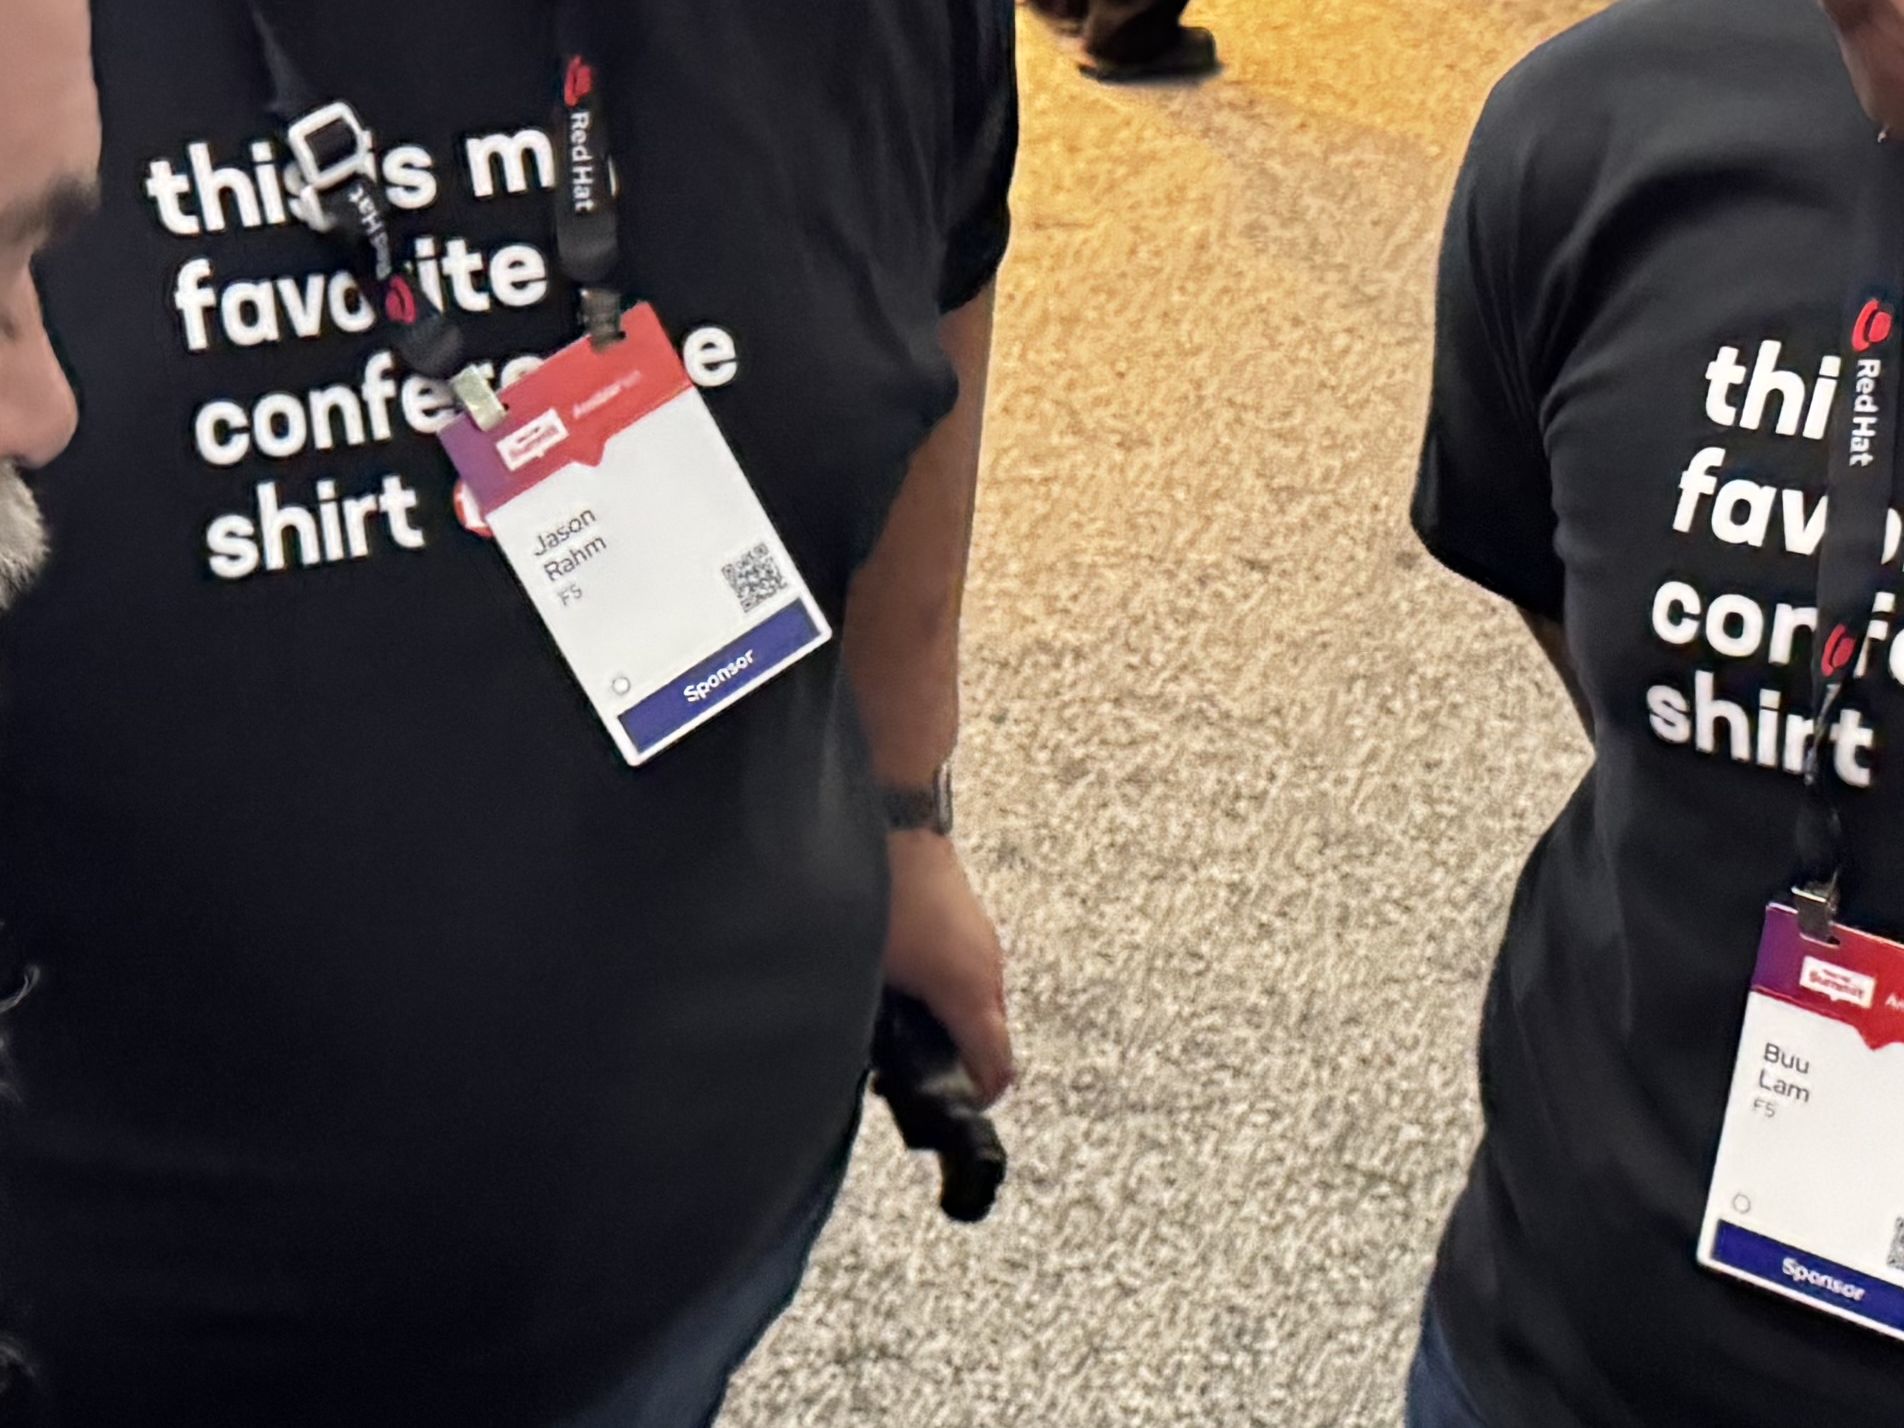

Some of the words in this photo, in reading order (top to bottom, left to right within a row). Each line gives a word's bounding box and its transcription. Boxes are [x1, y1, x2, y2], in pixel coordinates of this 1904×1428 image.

[570, 111, 593, 162] Red
[572, 166, 595, 212] Hat
[174, 235, 549, 350] favoite
[1704, 339, 1841, 441] thi
[1853, 358, 1881, 410] Red
[1849, 412, 1878, 467] Hat
[205, 476, 425, 578] shirt
[533, 507, 596, 557] Jason
[543, 534, 608, 582] Rahm
[683, 649, 755, 704] Sponsor
[1763, 1042, 1810, 1075] Buu
[1758, 1070, 1811, 1104] Lam
[1782, 1256, 1866, 1303] Sponsor
